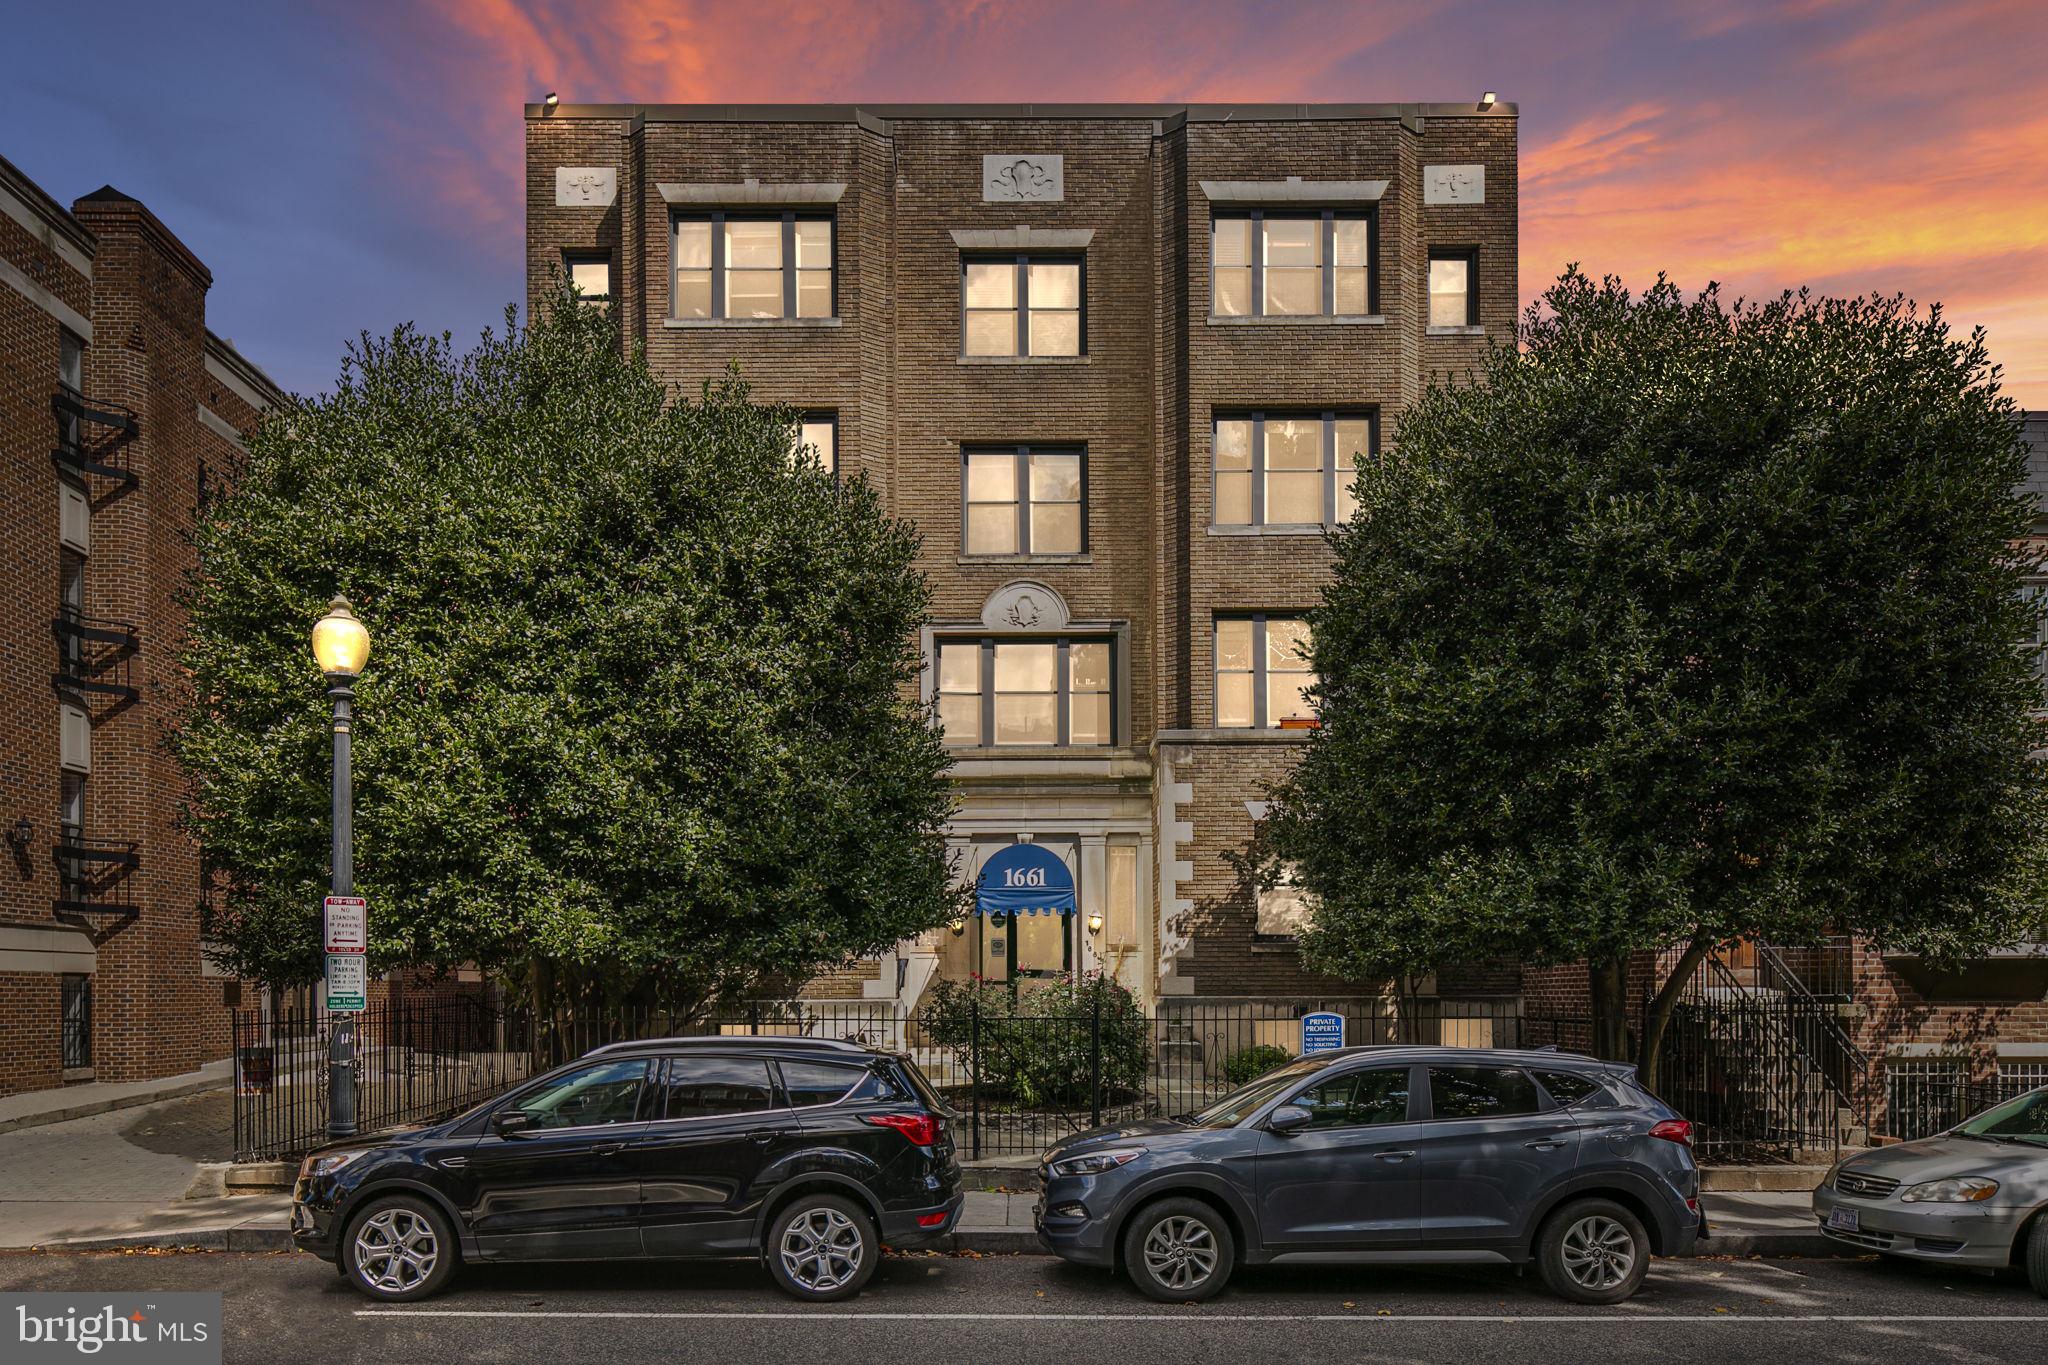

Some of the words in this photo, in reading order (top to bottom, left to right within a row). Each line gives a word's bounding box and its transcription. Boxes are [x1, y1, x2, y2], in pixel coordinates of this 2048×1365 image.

[1004, 867, 1047, 887] 1661
[330, 958, 342, 966] TWO
[343, 958, 361, 966] HOUR
